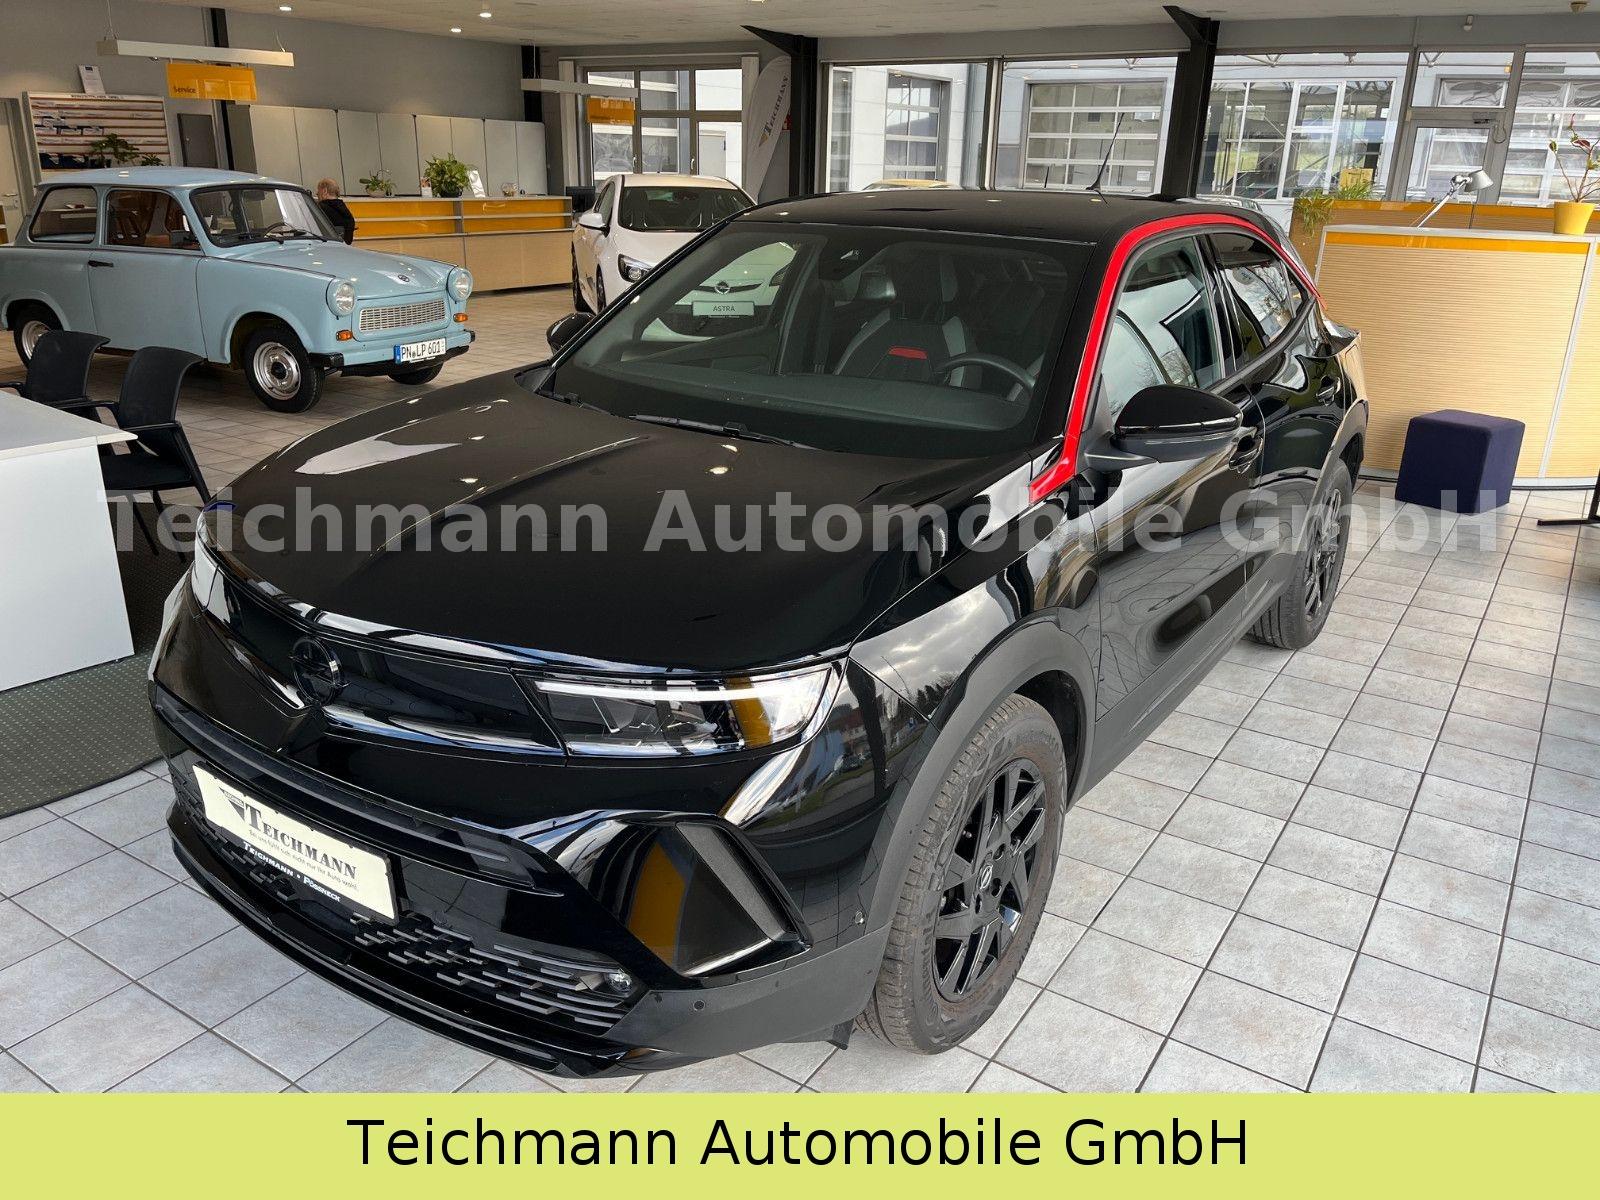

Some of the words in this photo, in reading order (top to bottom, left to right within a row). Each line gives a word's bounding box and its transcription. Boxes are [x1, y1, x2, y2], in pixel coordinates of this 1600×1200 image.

[174, 85, 196, 94] Service
[401, 346, 411, 359] PN
[416, 343, 426, 357] LP
[428, 341, 440, 354] 601
[245, 803, 357, 880] TEICHMANN
[243, 841, 294, 877] TEICHMANN
